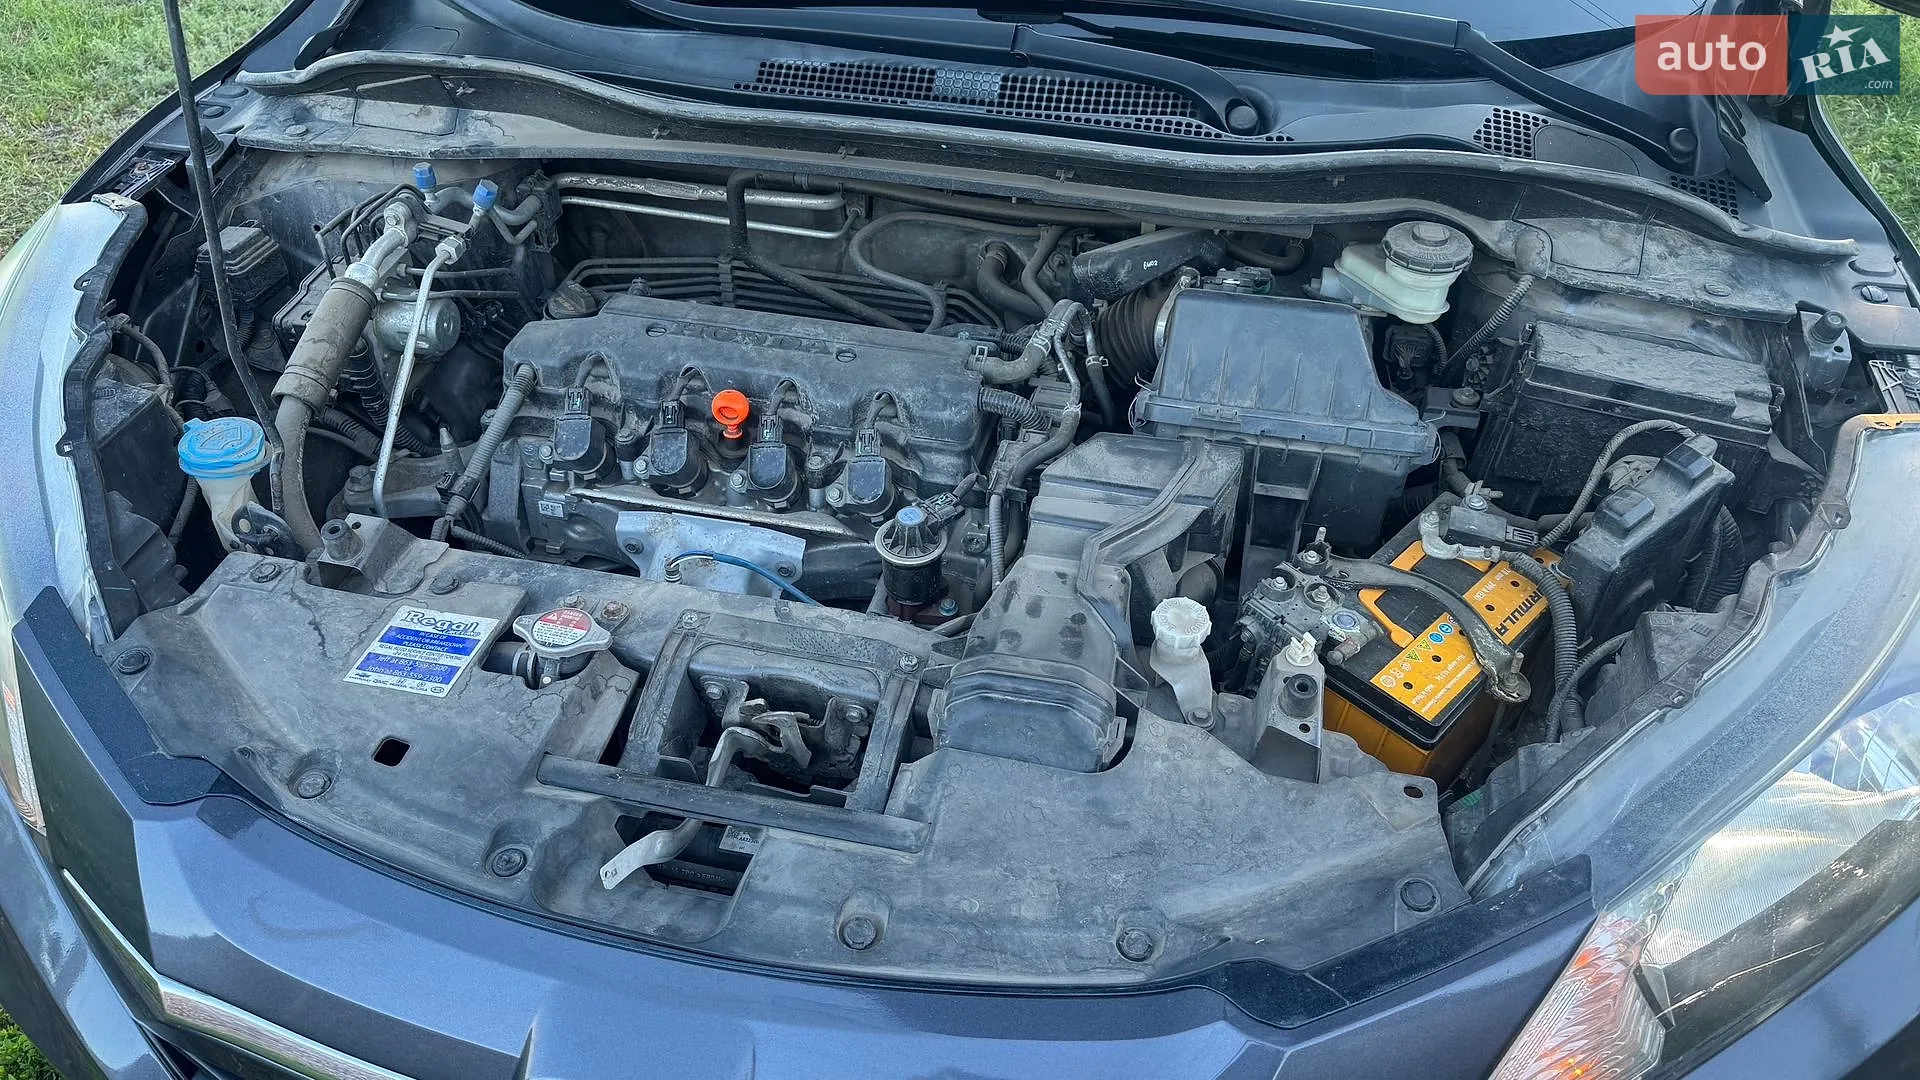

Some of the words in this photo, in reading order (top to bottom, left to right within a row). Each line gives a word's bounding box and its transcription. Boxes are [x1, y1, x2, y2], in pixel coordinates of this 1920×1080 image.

[1495, 590, 1542, 636] RMULA
[400, 610, 479, 632] Regal
[420, 643, 449, 652] CONTACT
[429, 639, 464, 648] BREAKDOWN
[365, 665, 385, 673] John
